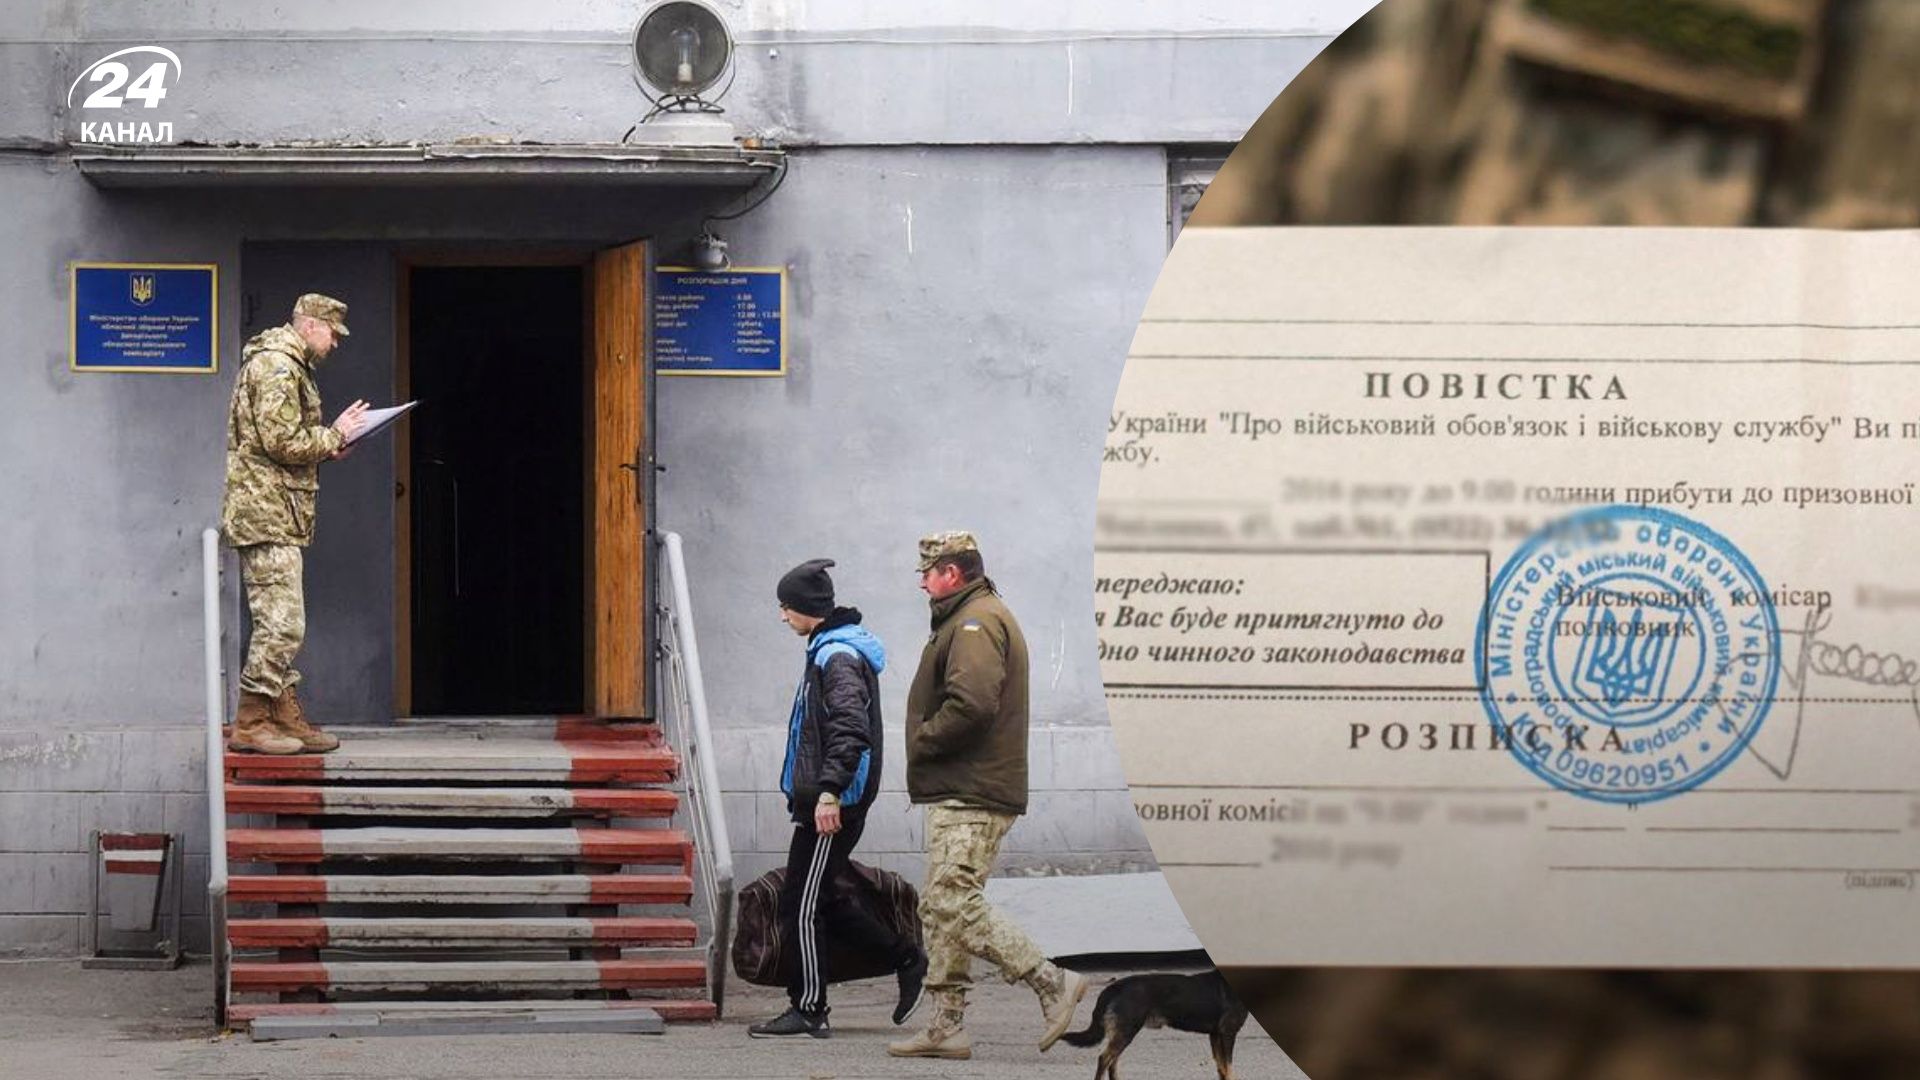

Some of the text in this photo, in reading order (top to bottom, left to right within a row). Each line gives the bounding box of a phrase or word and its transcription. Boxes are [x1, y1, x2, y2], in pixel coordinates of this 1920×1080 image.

[1365, 371, 1629, 401] ПОВІСТКА
[1108, 411, 1208, 439] України
[1219, 411, 1282, 440] "Про
[1293, 412, 1436, 437] військовий
[1447, 413, 1569, 438] обов'язок
[1578, 414, 1586, 437] і
[1598, 414, 1723, 444] військову
[1733, 414, 1842, 444] службу"
[1853, 416, 1890, 439] Ви
[1102, 439, 1160, 469] жбу.
[1524, 484, 1616, 505] години
[1625, 481, 1734, 510] прибути
[1742, 486, 1774, 507] до
[1782, 485, 1913, 510] призовної
[1577, 552, 1667, 578] міський
[1095, 570, 1244, 600] переджаю:
[1556, 583, 1706, 608] Військовий
[1730, 583, 1832, 613] комісар
[1113, 605, 1164, 629] Вас
[1169, 605, 1228, 634] буде
[1234, 611, 1405, 636] притягнуто
[1413, 608, 1444, 631] до
[1556, 618, 1697, 639] полковник
[1636, 522, 1746, 602] оборони
[1716, 612, 1763, 735] України
[1147, 644, 1255, 664] чинного
[1261, 642, 1465, 665] законодавства
[1347, 722, 1625, 752] РОЗПИСКА
[1555, 750, 1690, 788] 09620951
